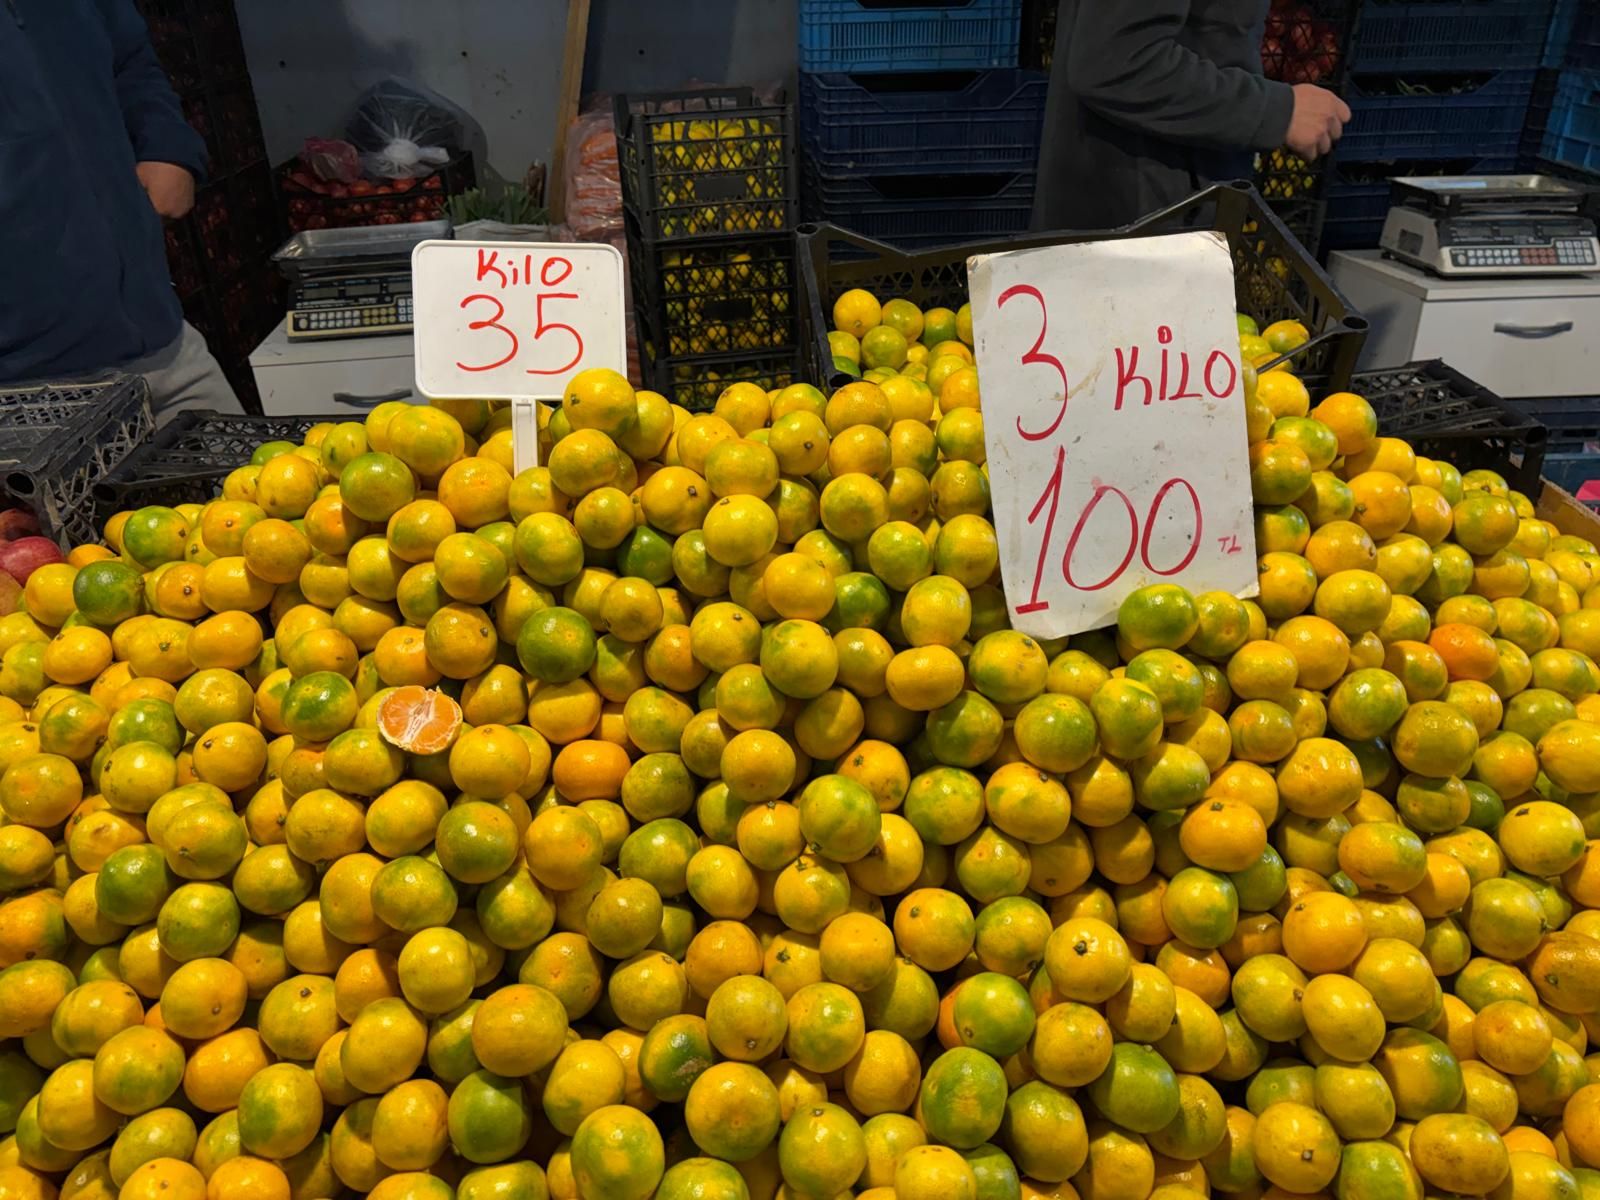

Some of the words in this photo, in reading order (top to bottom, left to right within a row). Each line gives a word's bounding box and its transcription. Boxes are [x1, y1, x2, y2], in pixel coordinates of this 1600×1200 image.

[455, 292, 585, 373] 35
[996, 283, 1069, 442] 3
[1013, 446, 1205, 615] 100
[1216, 534, 1242, 555] TL
